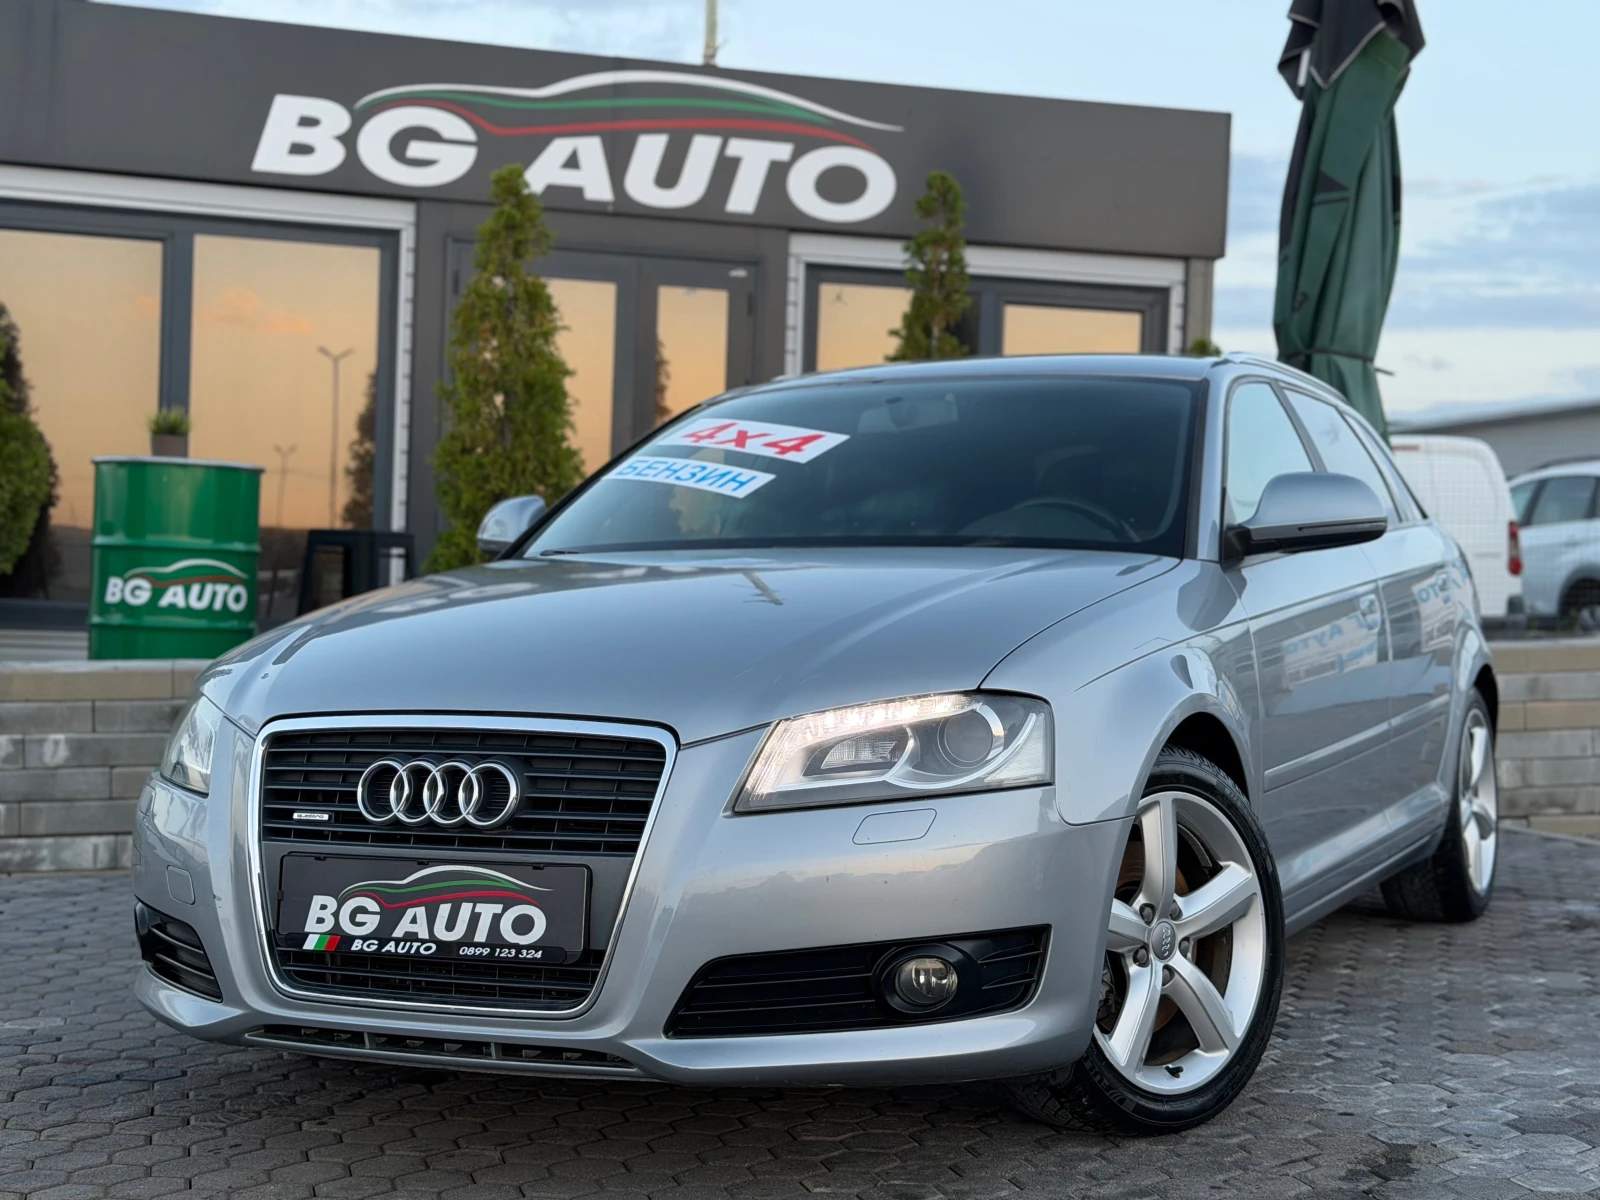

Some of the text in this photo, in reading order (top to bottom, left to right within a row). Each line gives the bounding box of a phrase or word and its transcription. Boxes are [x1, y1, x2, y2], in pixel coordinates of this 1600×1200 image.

[250, 93, 897, 223] BG AUTO
[616, 459, 758, 492] БЕНЗИН
[104, 576, 249, 613] BG AUTO
[304, 895, 546, 945] BG AUTO
[350, 939, 543, 959] BG AUTO 0899 123 324
